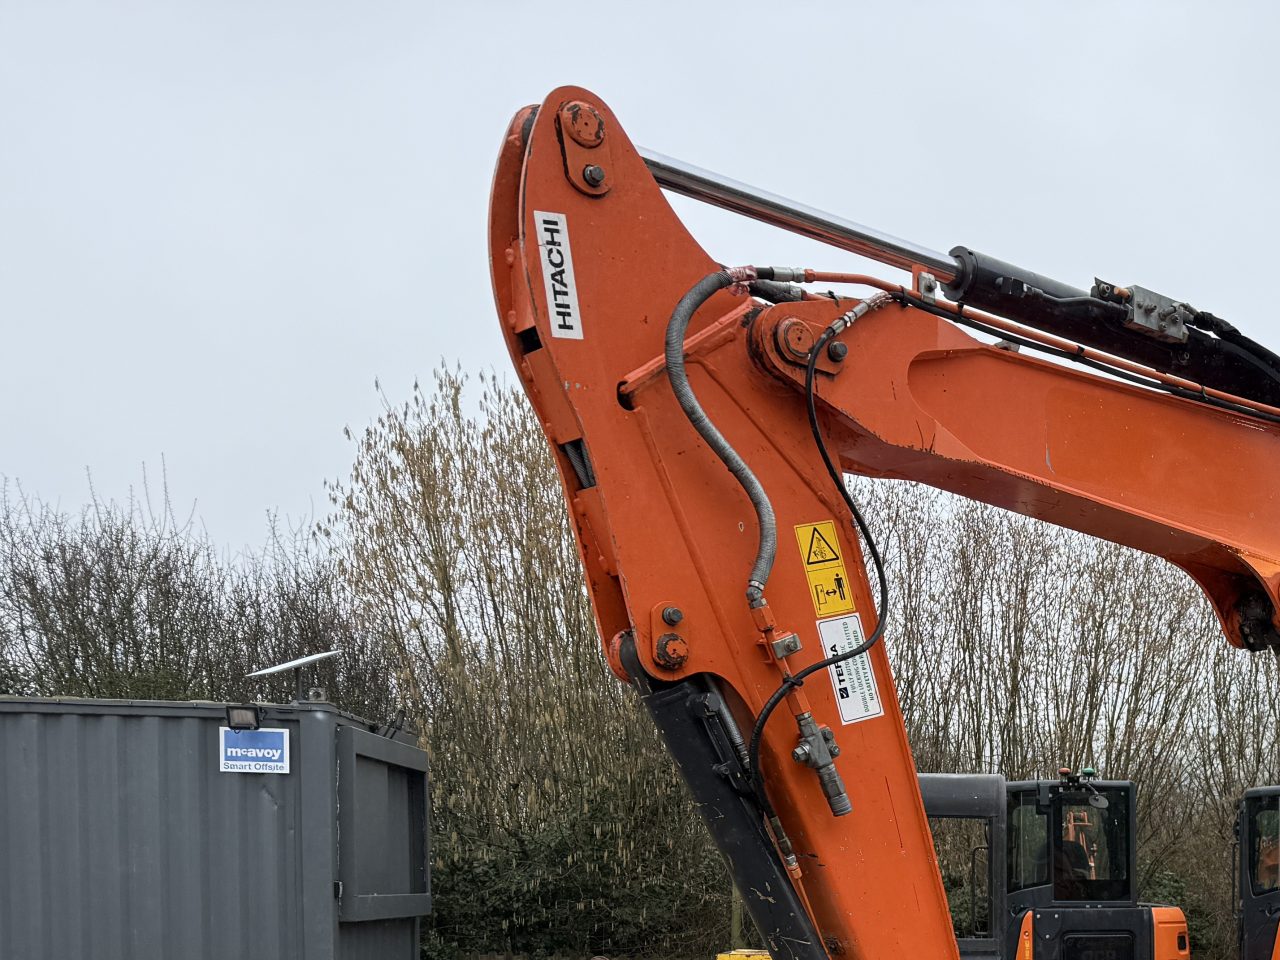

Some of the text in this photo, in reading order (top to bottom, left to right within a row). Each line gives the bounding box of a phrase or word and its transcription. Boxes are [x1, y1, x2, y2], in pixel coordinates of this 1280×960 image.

[543, 219, 573, 330] HITACHI
[863, 671, 872, 691] SAFETY
[224, 762, 284, 771] Smart Offsite
